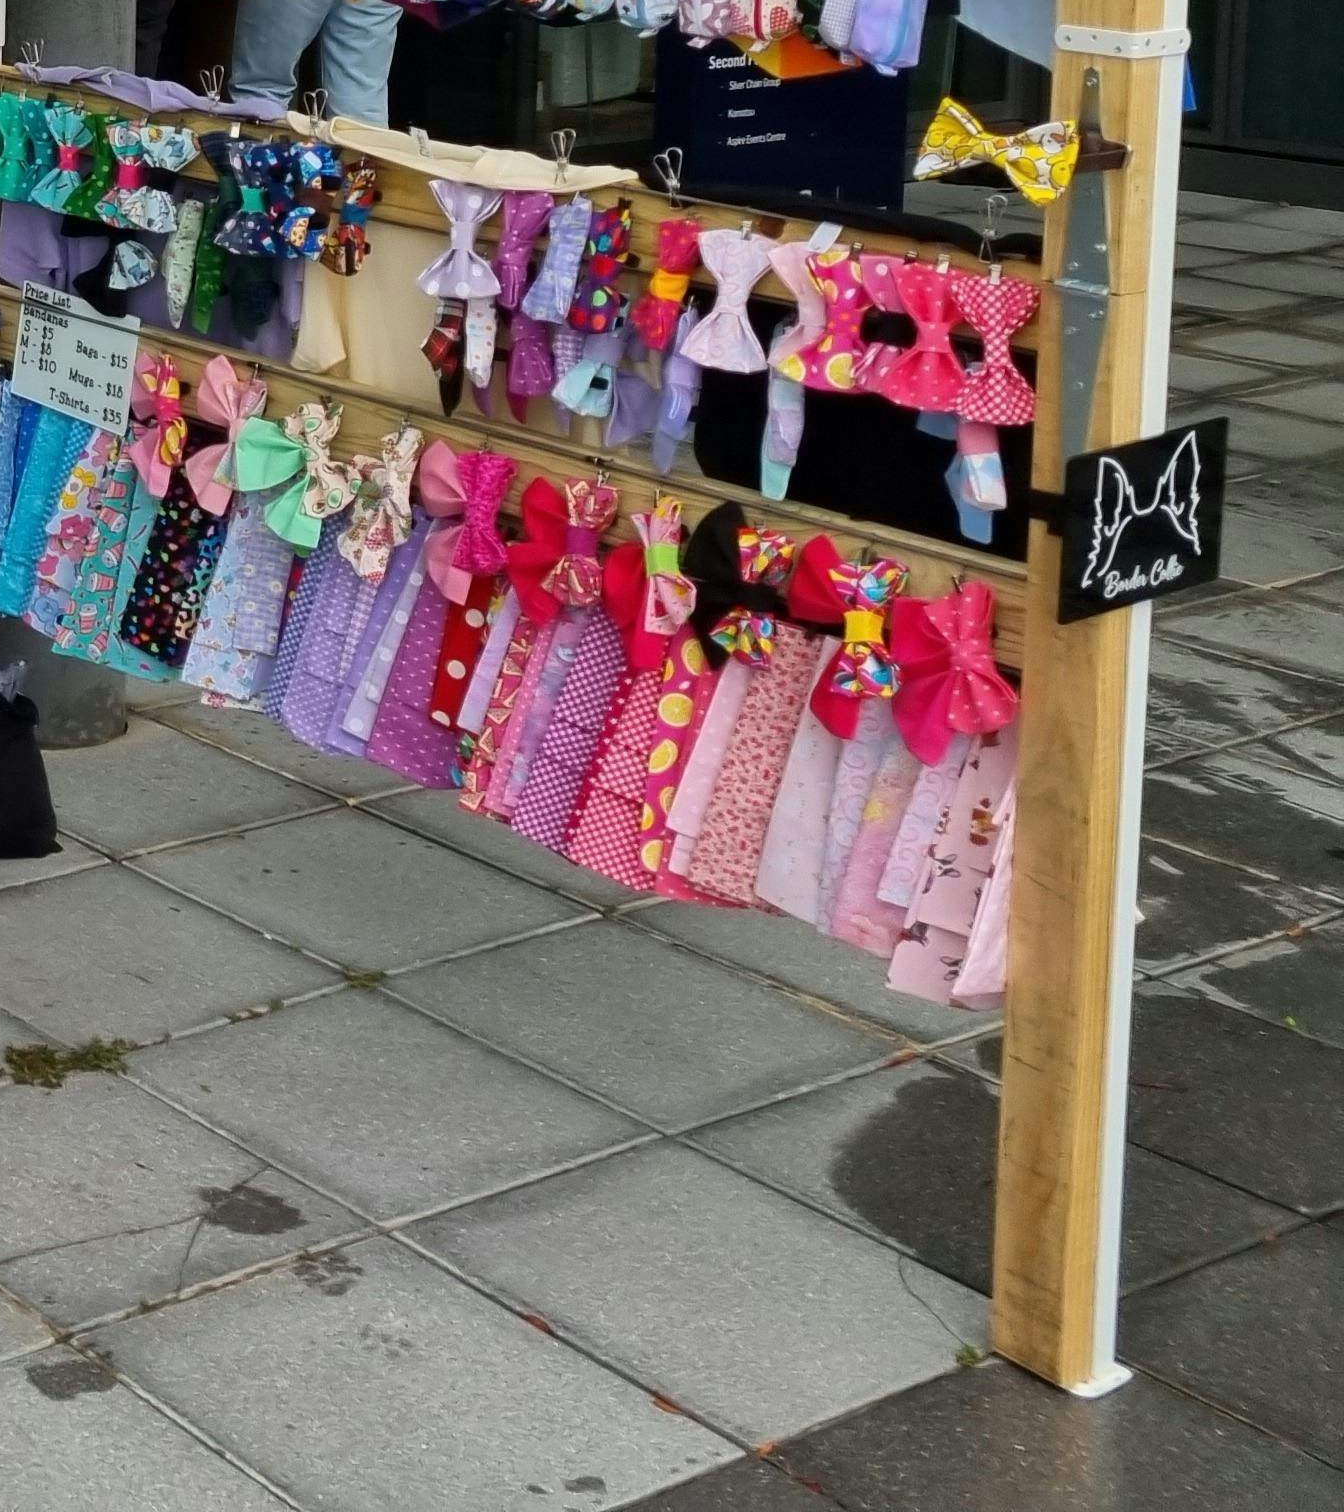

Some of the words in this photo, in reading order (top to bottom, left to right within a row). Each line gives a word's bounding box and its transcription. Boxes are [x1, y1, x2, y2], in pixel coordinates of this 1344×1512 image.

[708, 52, 747, 70] Second
[25, 283, 49, 302] Price
[52, 292, 72, 309] List
[23, 304, 70, 329] Bandanas
[23, 320, 32, 332] S
[42, 326, 54, 340] $5
[20, 335, 30, 349] M
[21, 351, 28, 364] L
[38, 357, 57, 373] $10
[110, 354, 128, 369] $15
[1103, 564, 1148, 599] Border
